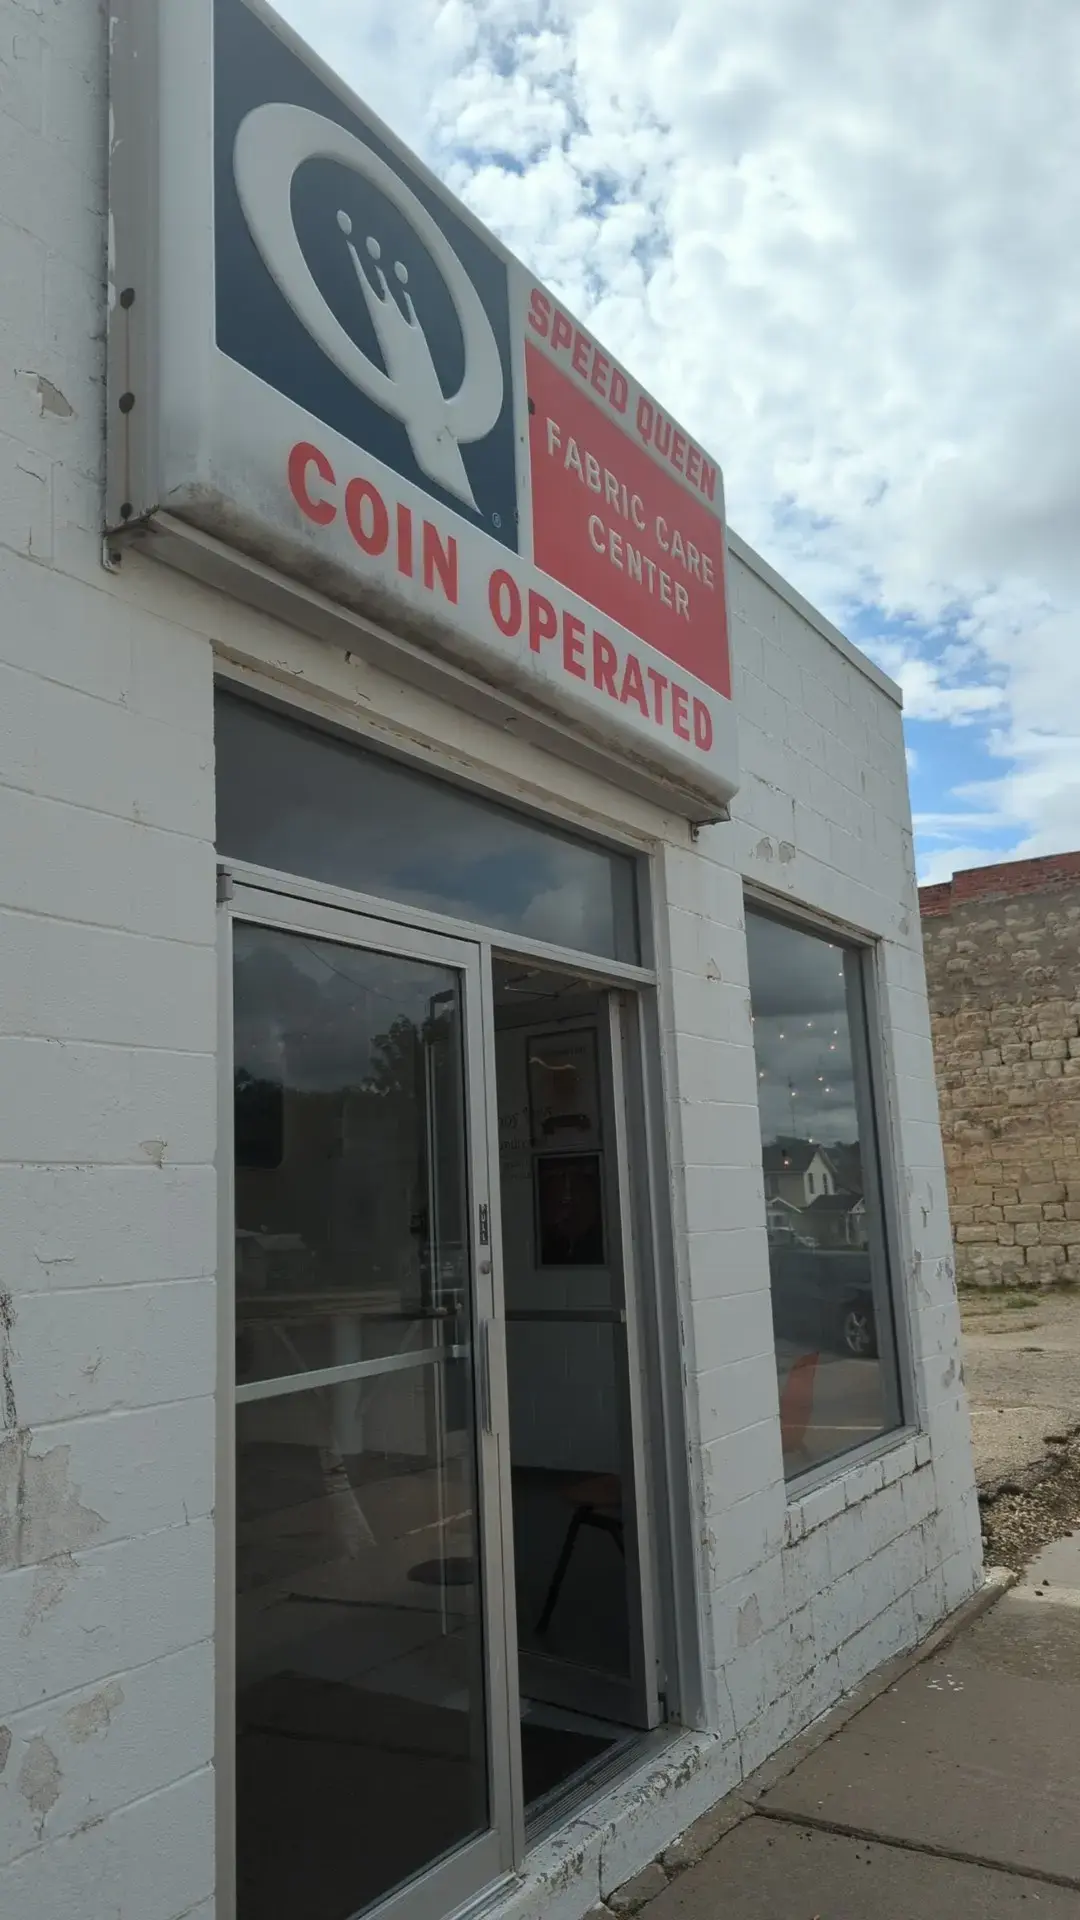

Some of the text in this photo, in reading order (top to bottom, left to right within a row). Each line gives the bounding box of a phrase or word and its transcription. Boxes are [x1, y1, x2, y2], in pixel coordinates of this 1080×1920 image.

[528, 287, 717, 502] SPEED QUEEN
[288, 440, 713, 752] COIN OPERATED
[546, 416, 715, 592] FABRIC CARE
[588, 514, 692, 622] CENTER
